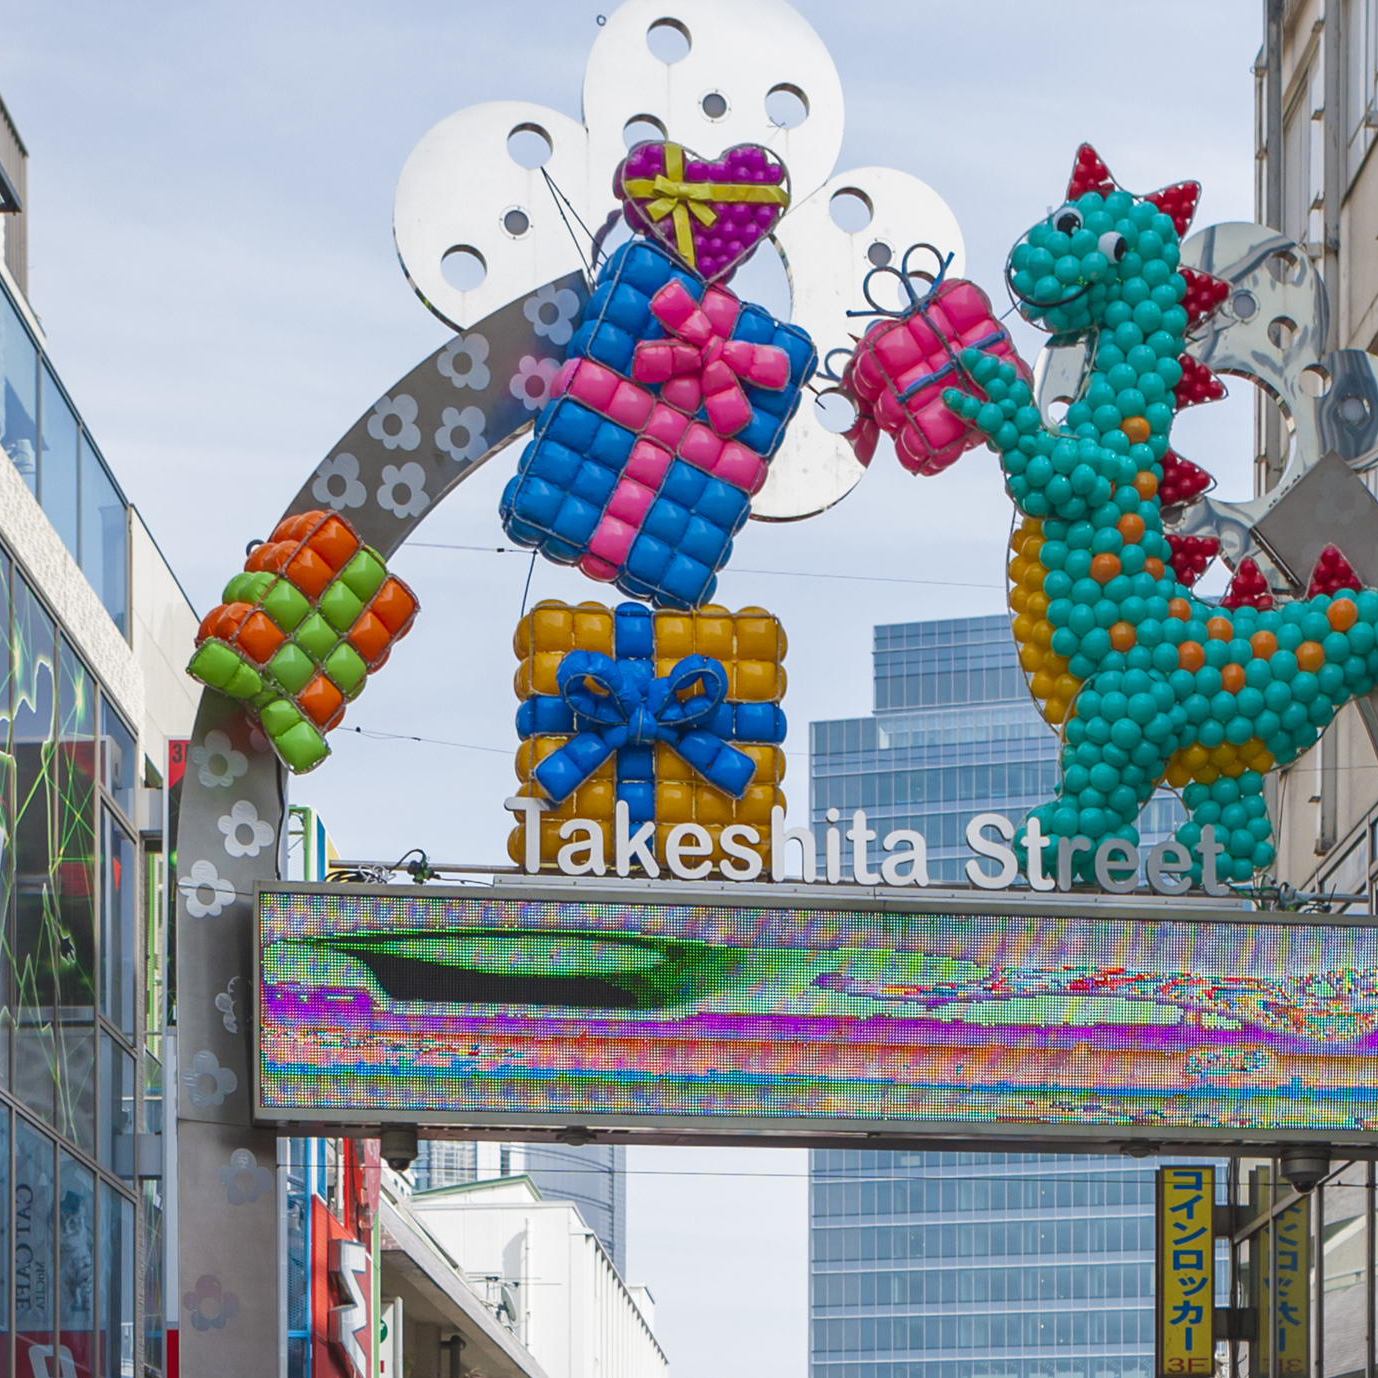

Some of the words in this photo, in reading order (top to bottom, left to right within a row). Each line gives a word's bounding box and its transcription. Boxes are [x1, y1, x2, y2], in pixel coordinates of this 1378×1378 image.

[506, 798, 930, 889] Takeshita
[965, 812, 1229, 898] Street
[1166, 1170, 1209, 1352] コインロッカー
[1166, 1356, 1208, 1375] 3F
